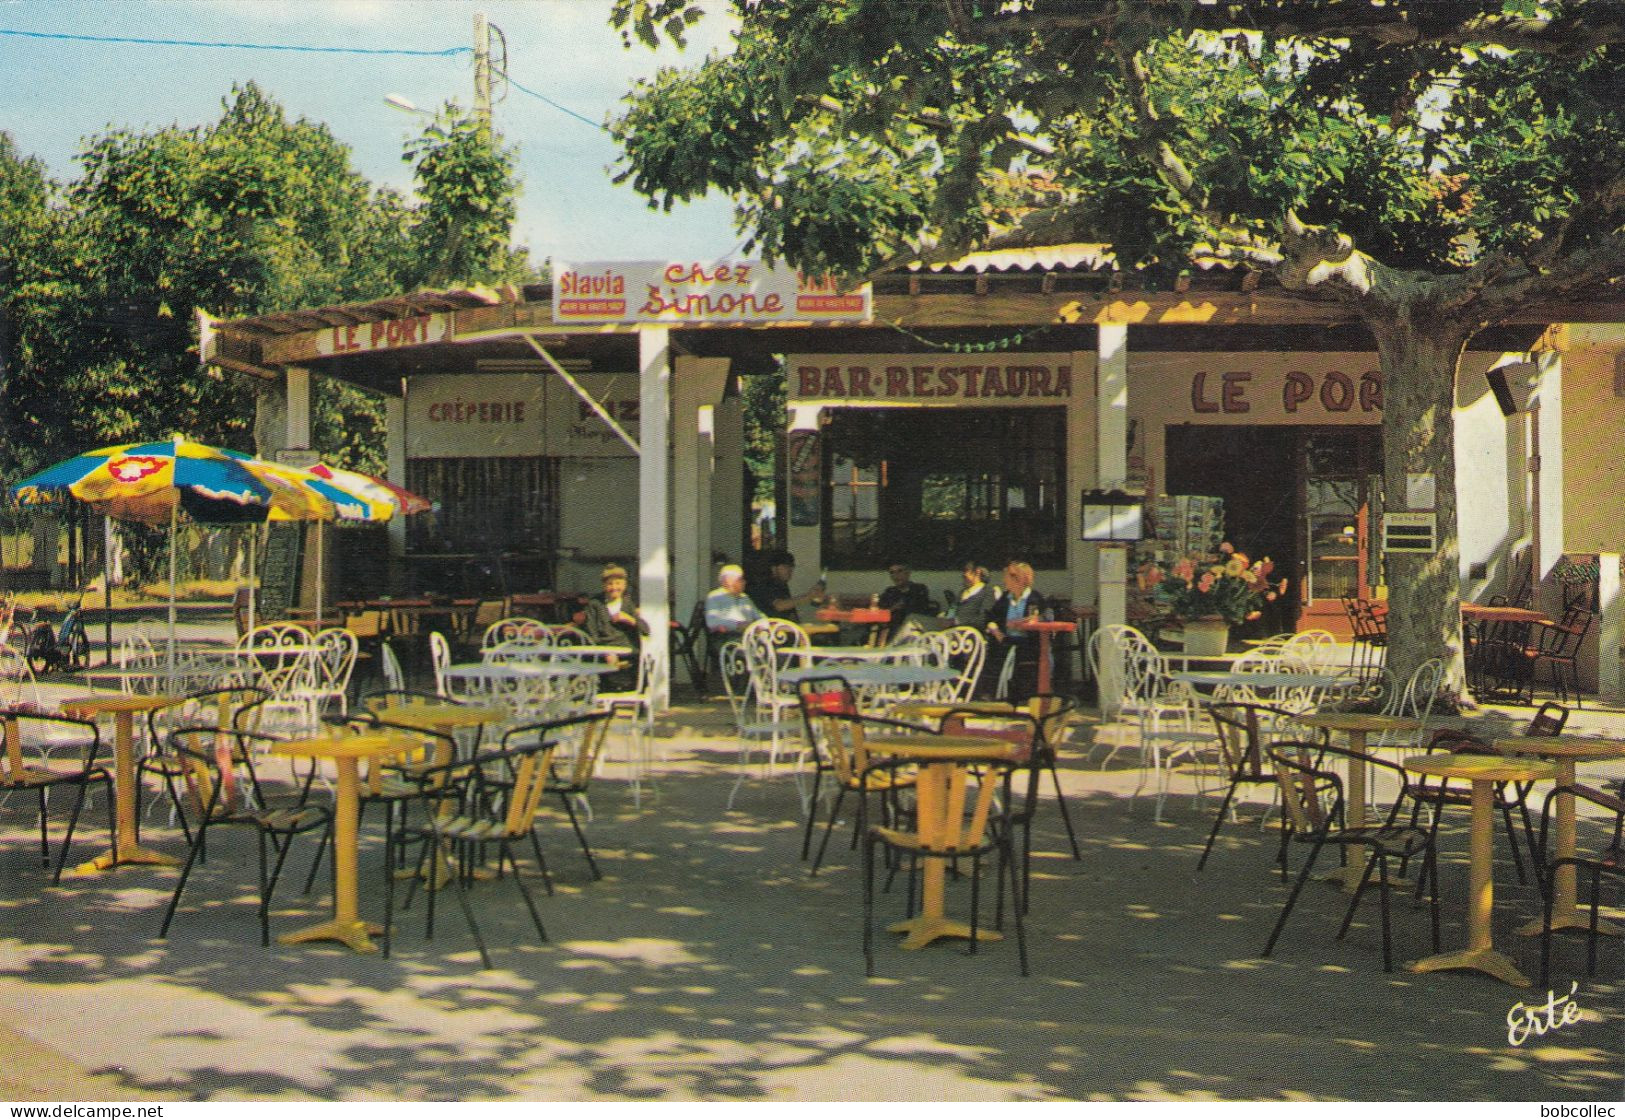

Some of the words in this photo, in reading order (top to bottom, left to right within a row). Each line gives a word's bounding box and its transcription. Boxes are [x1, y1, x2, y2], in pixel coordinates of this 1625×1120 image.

[560, 270, 625, 294] Slavia
[664, 262, 751, 284] Chez
[638, 283, 783, 315] Simone
[333, 324, 361, 351] LE
[370, 313, 432, 348] PORT
[1191, 371, 1252, 413] LE
